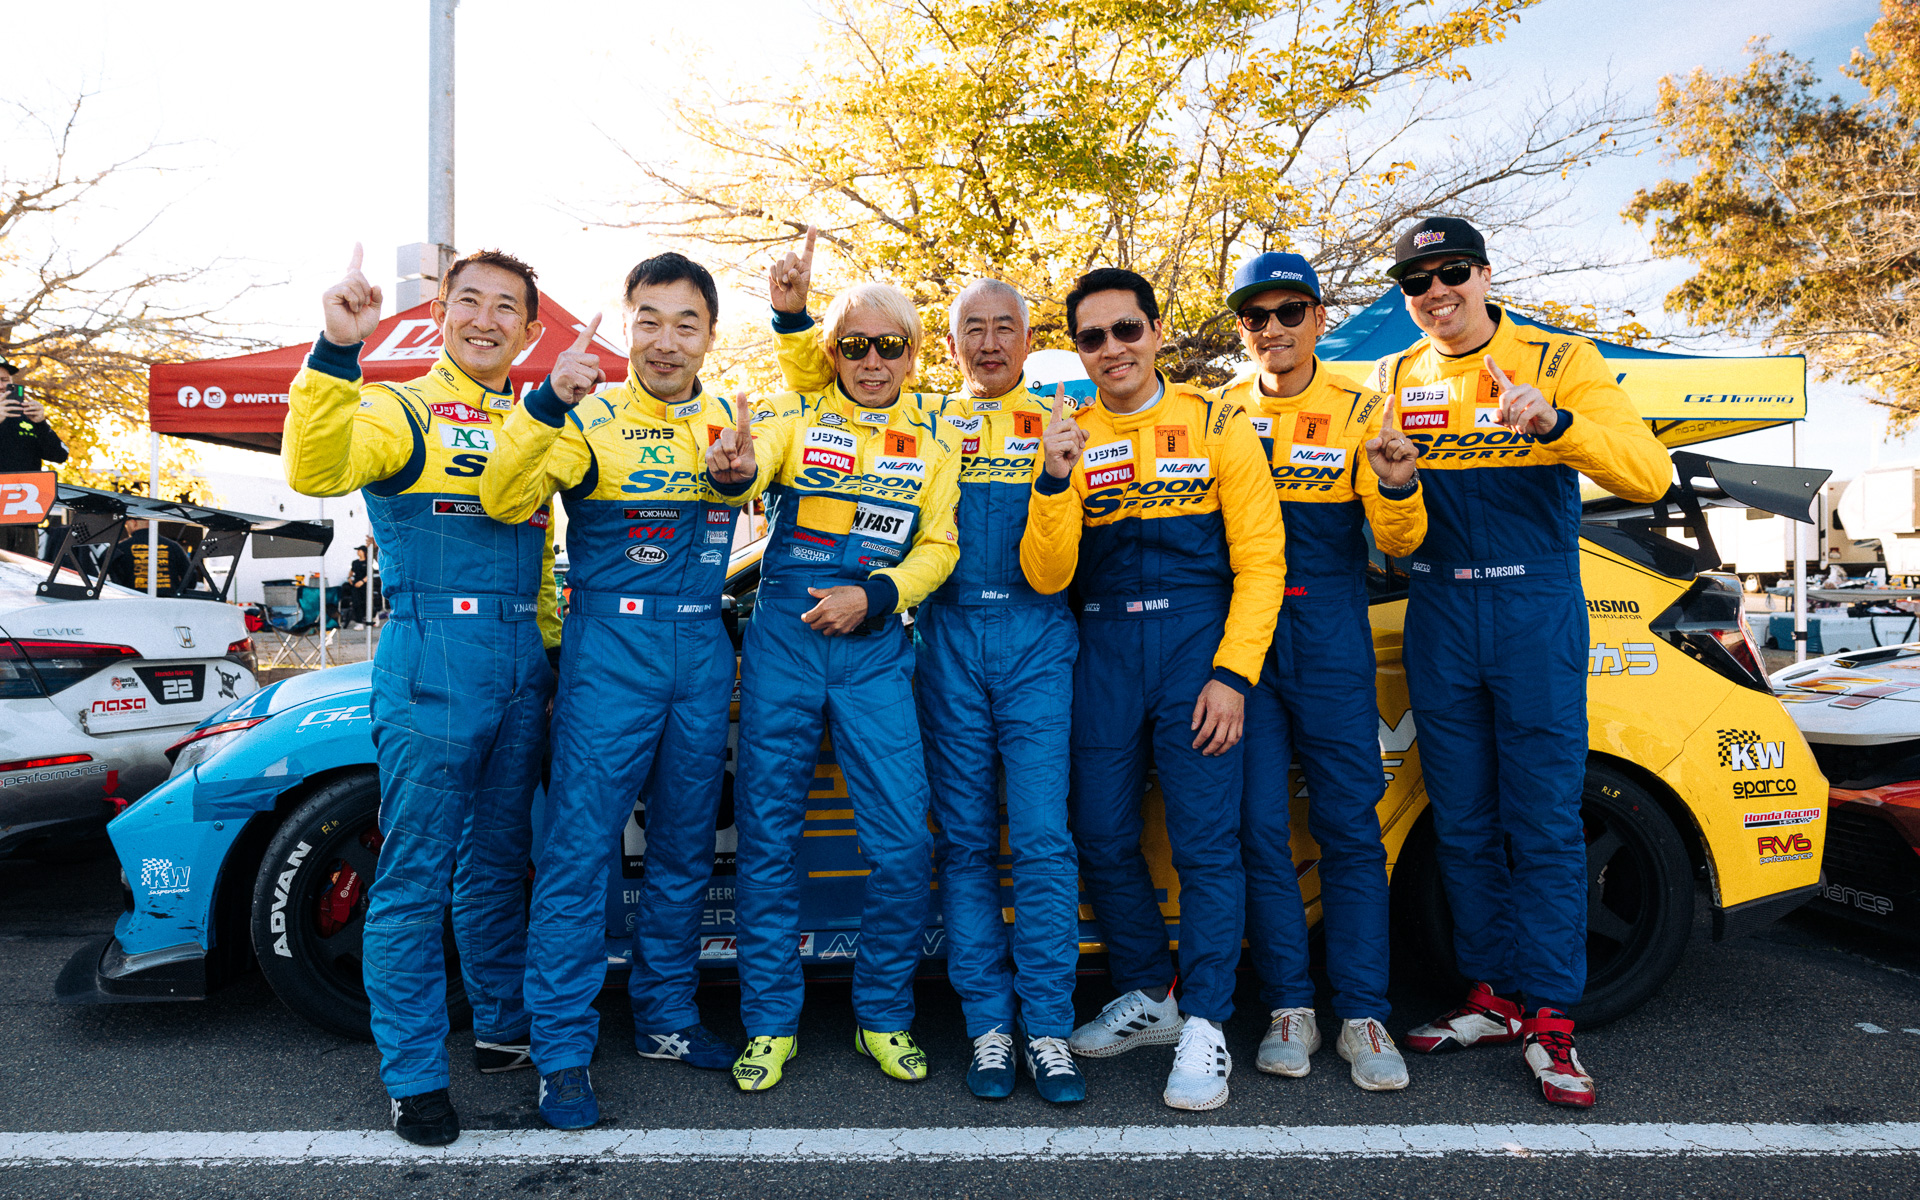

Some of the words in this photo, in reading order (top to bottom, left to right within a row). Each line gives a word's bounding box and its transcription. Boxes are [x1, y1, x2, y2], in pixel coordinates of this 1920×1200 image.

[1419, 232, 1445, 245] KW
[1546, 342, 1569, 378] sparco
[1407, 391, 1444, 402] リジカラ
[679, 403, 699, 414] ARD
[1404, 414, 1445, 427] MOTUL
[451, 428, 489, 450] AG
[622, 428, 675, 440] リジカラ
[811, 432, 853, 447] リジカラ
[638, 445, 675, 464] AG
[806, 451, 851, 470] MOTUL
[1088, 445, 1128, 462] リジカラ
[1425, 449, 1531, 460] SPORTS
[794, 467, 922, 491] SPOON
[1090, 467, 1132, 486] MOTUL
[1084, 477, 1216, 518] SPOON
[1123, 496, 1206, 509] PORTS
[707, 511, 730, 522] MOTUL
[863, 513, 904, 534] FAST
[628, 527, 676, 539] KYB
[1474, 568, 1483, 578] C.
[1485, 564, 1526, 578] PARSONS
[1144, 598, 1169, 611] WANG
[33, 627, 84, 636] CIVIC
[162, 679, 194, 700] 22
[92, 698, 146, 713] nasa
[1730, 742, 1785, 771] KW
[4, 764, 108, 788] performance
[1733, 778, 1797, 799] sparco
[1745, 812, 1782, 822] Honda
[1784, 809, 1820, 819] Racing
[1758, 833, 1812, 855] RV6
[1760, 852, 1813, 864] performance
[150, 866, 190, 889] KW
[270, 841, 313, 958] ADVAN
